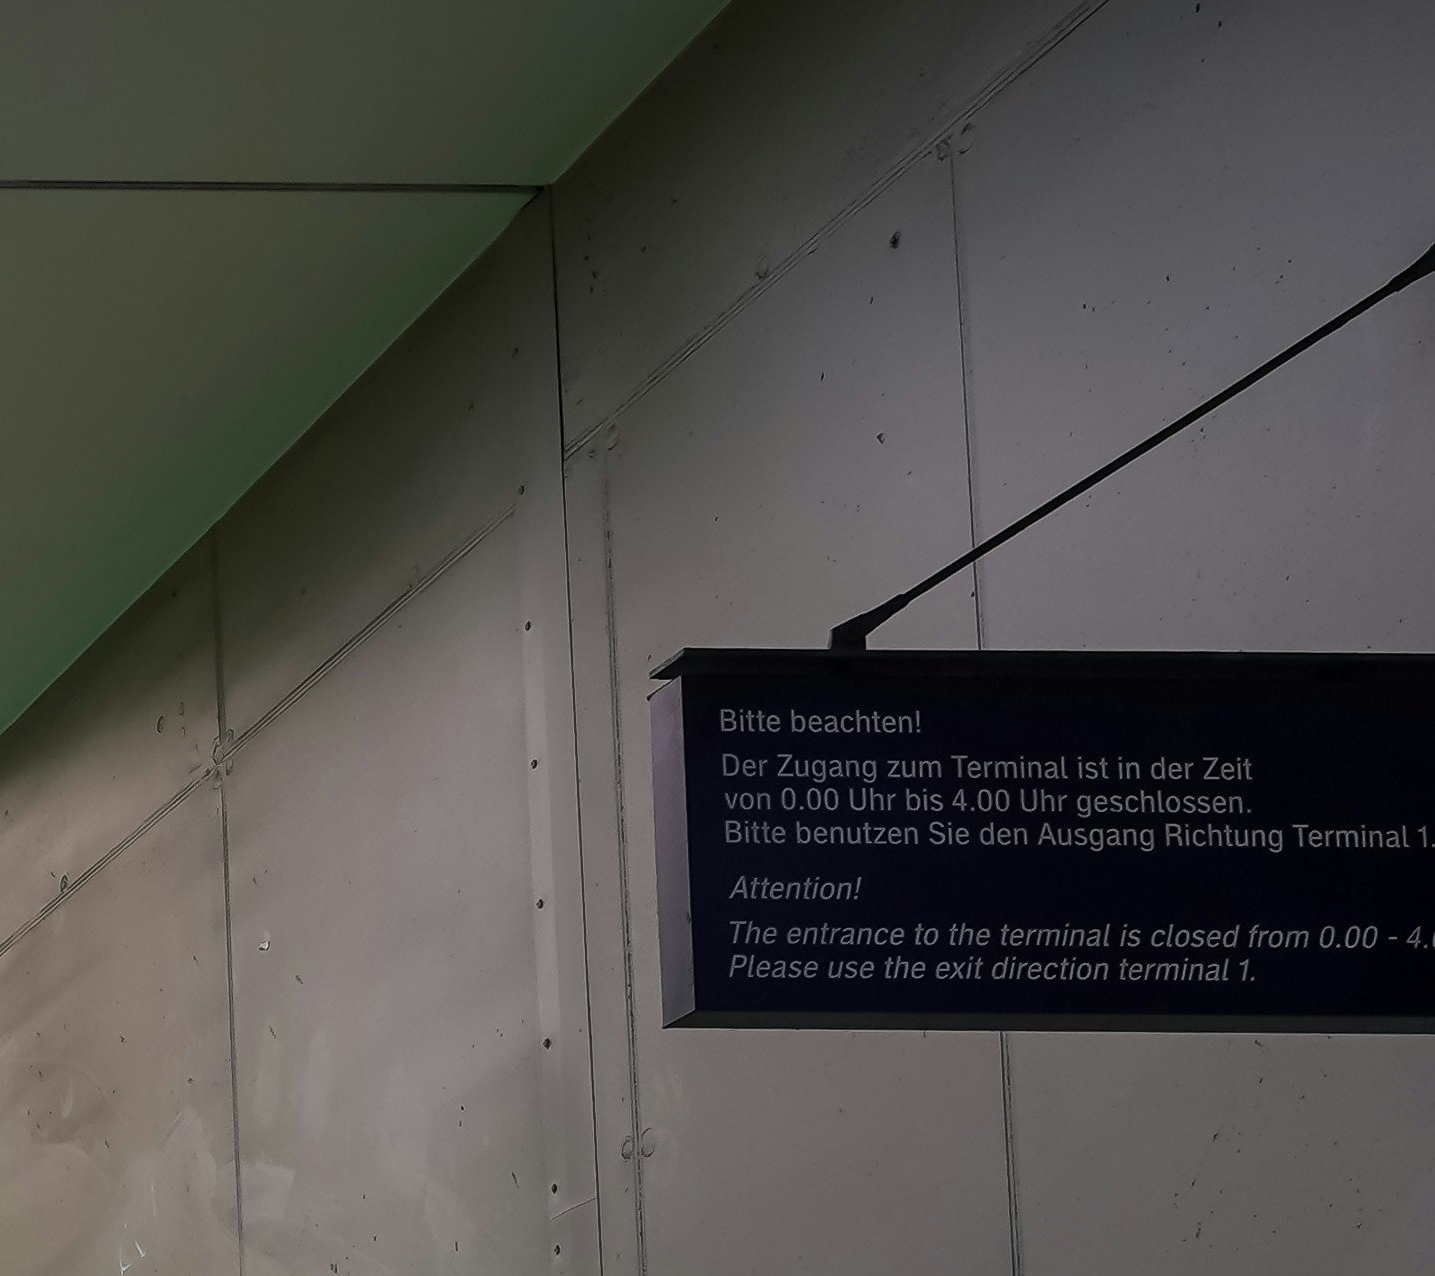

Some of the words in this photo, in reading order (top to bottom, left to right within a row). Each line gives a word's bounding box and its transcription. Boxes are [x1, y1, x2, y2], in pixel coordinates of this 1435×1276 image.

[720, 708, 781, 733] Bitte
[790, 709, 921, 734] beachten!
[722, 753, 768, 777] Der
[777, 753, 877, 784] Zugang
[886, 760, 942, 778] zum
[950, 755, 1069, 780] Terminal
[1077, 756, 1110, 780] ist
[1117, 756, 1141, 780] in
[1150, 756, 1194, 780] der
[1202, 756, 1253, 781] Zeit
[724, 792, 771, 810] von
[781, 787, 839, 811] 0.00
[849, 787, 897, 811] Uhr
[905, 788, 944, 812] bis
[951, 788, 1010, 812] 4.00
[1020, 788, 1068, 813] Uhr
[1076, 789, 1252, 819] geschlossen.
[725, 820, 786, 844] Bitte
[796, 820, 919, 845] benutzen
[928, 821, 970, 846] Sie
[979, 821, 1028, 846] den
[1037, 822, 1155, 852] Ausgang
[1165, 822, 1283, 854] Richtung
[1291, 824, 1410, 848] Terminal
[728, 875, 862, 900] Attention!
[729, 920, 778, 945] The
[787, 922, 905, 946] entrance
[914, 923, 939, 946] to
[949, 922, 991, 946] the
[1000, 922, 1111, 947] terminal
[1119, 923, 1141, 948] is
[1150, 923, 1241, 948] closed
[1248, 924, 1310, 949] from
[1319, 925, 1378, 949] 0.00
[1406, 926, 1435, 949] 4.
[729, 954, 819, 979] Please
[828, 960, 875, 979] use
[884, 955, 926, 980] the
[935, 955, 984, 980] exit
[991, 956, 1109, 981] direction
[1119, 957, 1229, 982] terminal
[1239, 958, 1256, 982] 1.
